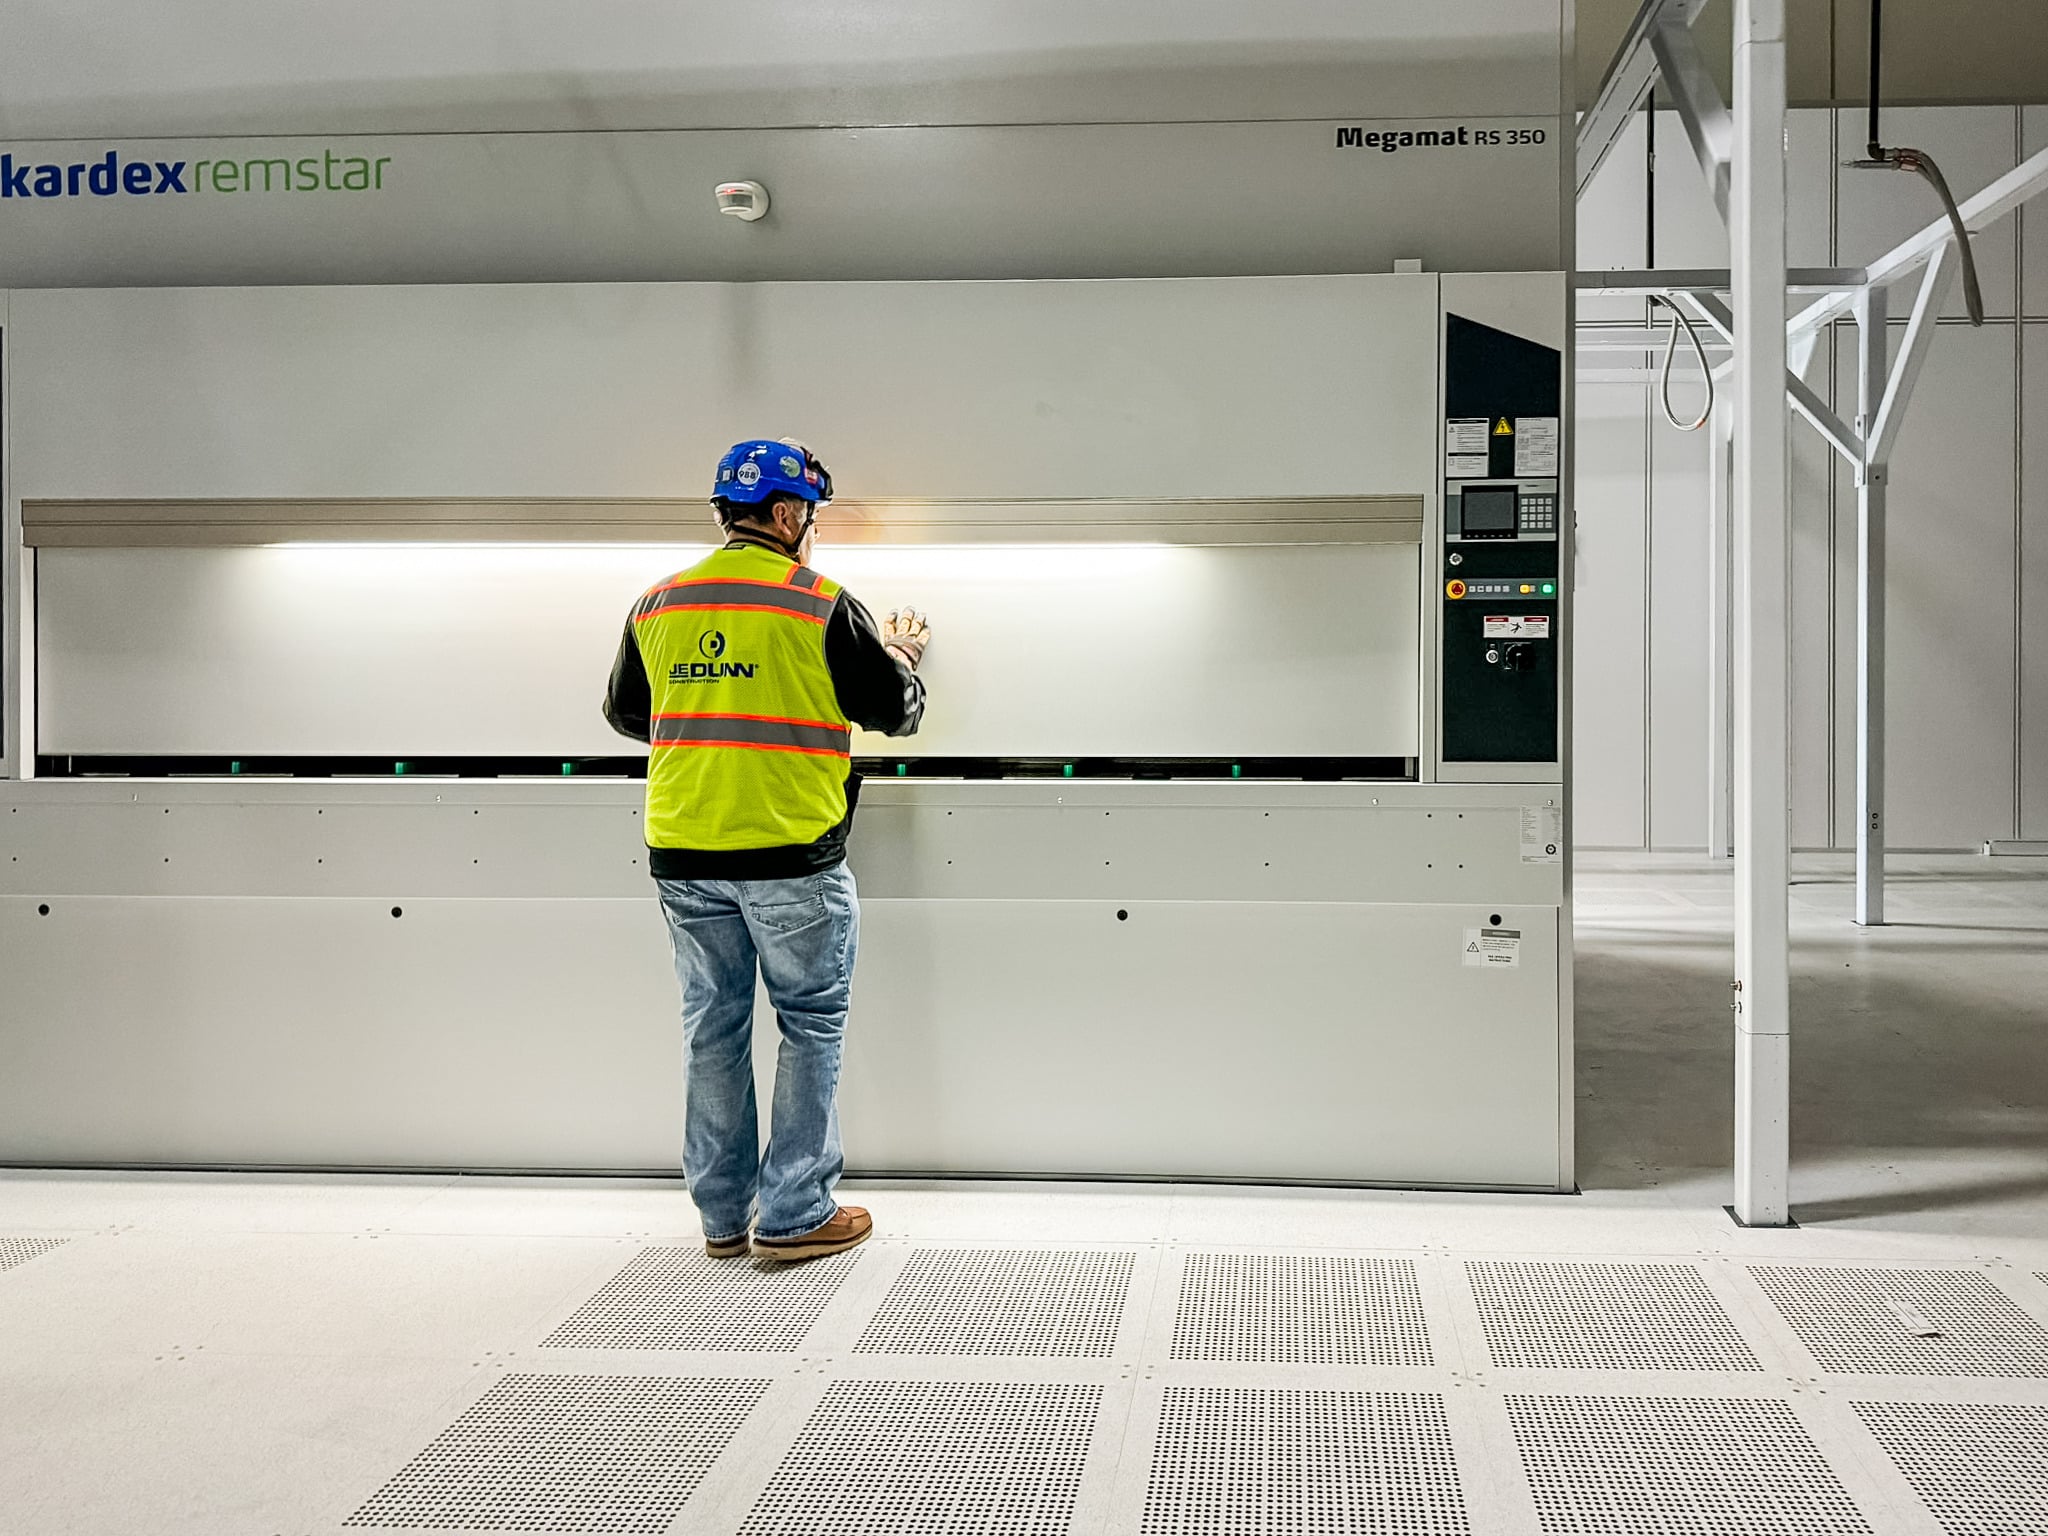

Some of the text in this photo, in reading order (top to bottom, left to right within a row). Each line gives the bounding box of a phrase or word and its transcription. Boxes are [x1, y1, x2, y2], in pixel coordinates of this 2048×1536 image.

[1336, 126, 1546, 153] Megamat RS 350
[739, 470, 756, 480] 988
